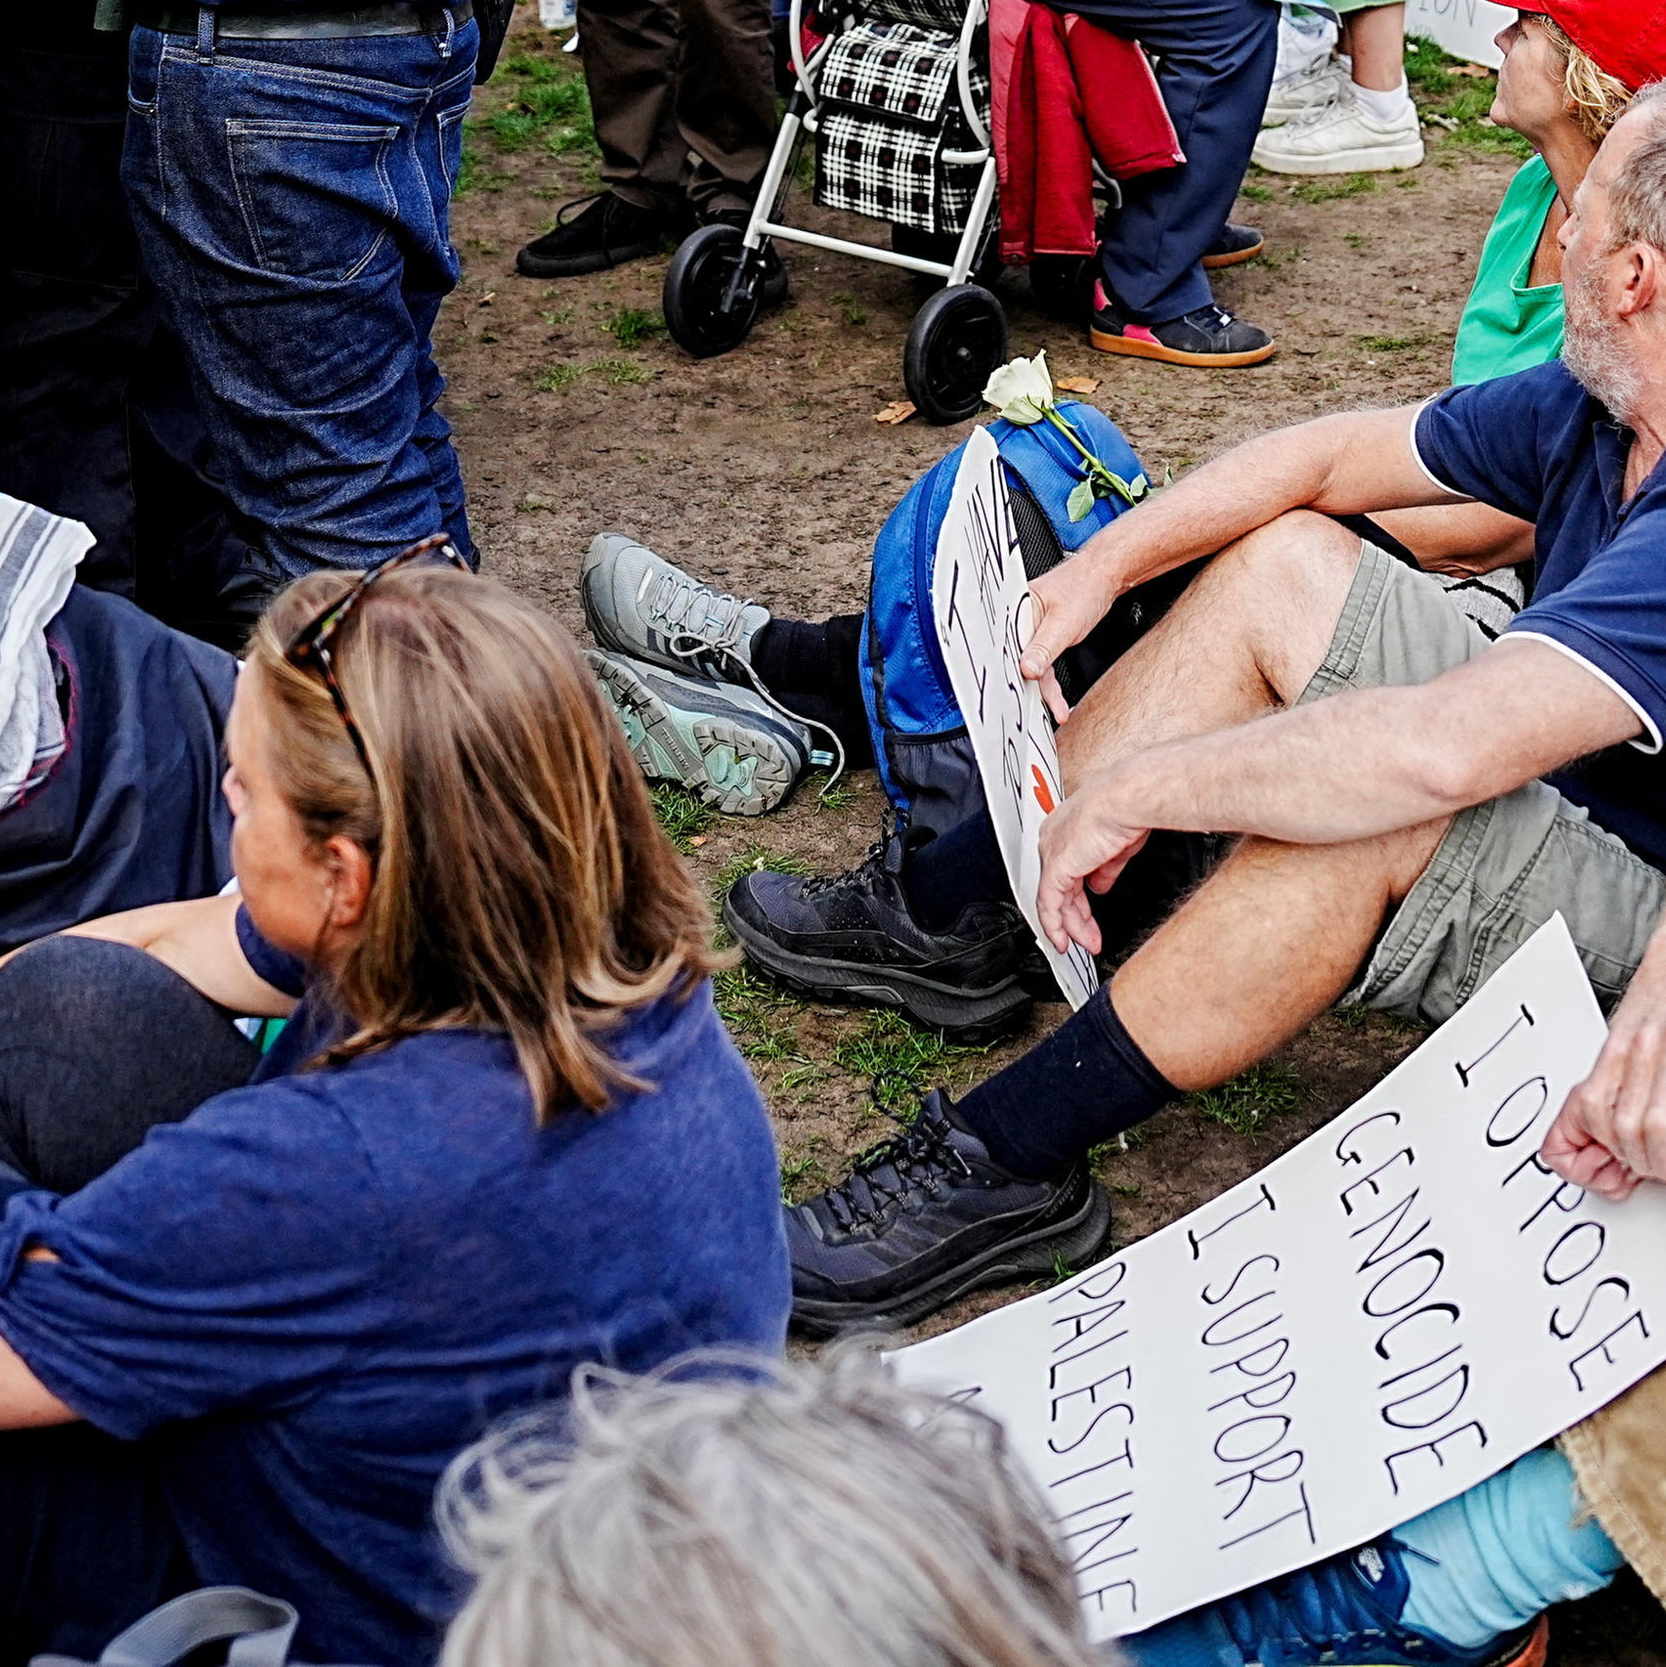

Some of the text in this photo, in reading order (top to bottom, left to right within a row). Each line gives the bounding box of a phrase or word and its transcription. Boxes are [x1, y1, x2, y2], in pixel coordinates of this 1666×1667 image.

[948, 560, 986, 725] I
[1188, 1184, 1317, 1551] I SUPPORT
[1336, 1110, 1487, 1495] GENOCIDE
[1455, 1004, 1650, 1392] I OPPOSE
[1047, 1261, 1138, 1614] PALESTINE
